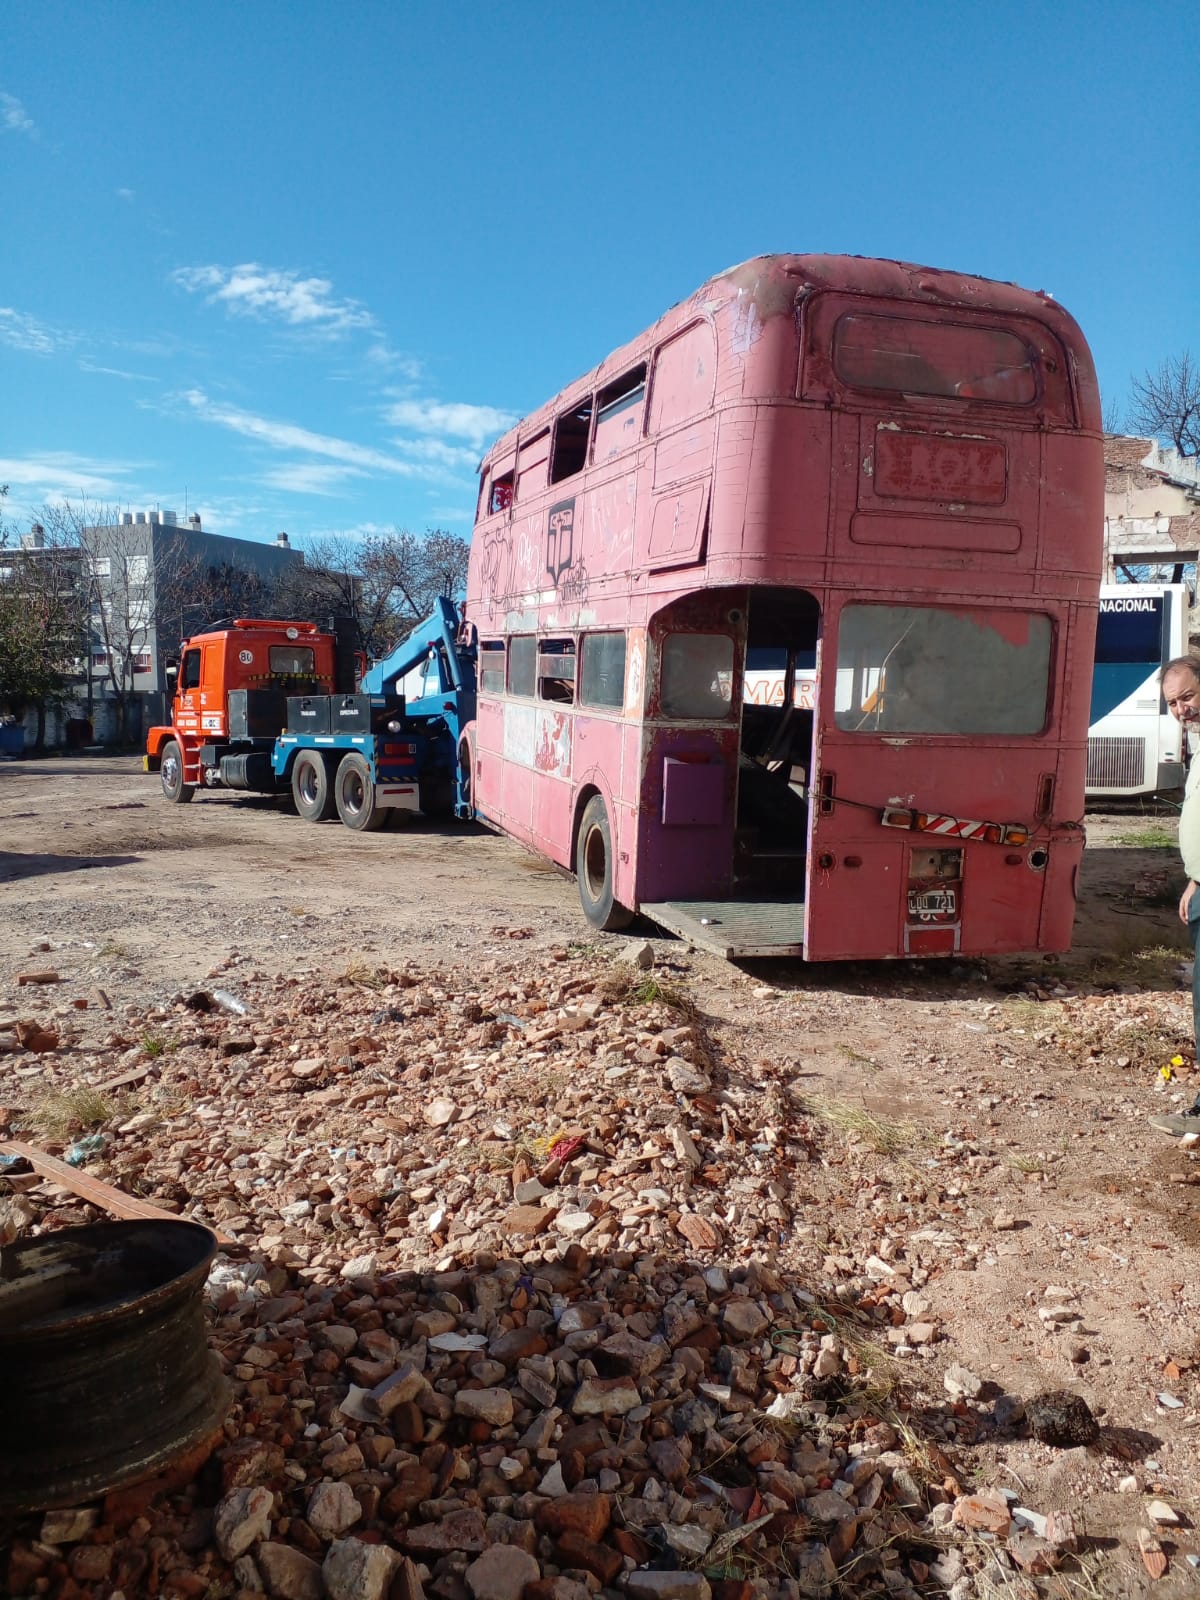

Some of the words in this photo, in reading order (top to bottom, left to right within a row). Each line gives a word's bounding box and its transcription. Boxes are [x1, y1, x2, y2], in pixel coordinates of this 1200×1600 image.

[1099, 599, 1157, 613] NACIONAL
[240, 652, 253, 662] 80
[935, 895, 953, 909] 721
